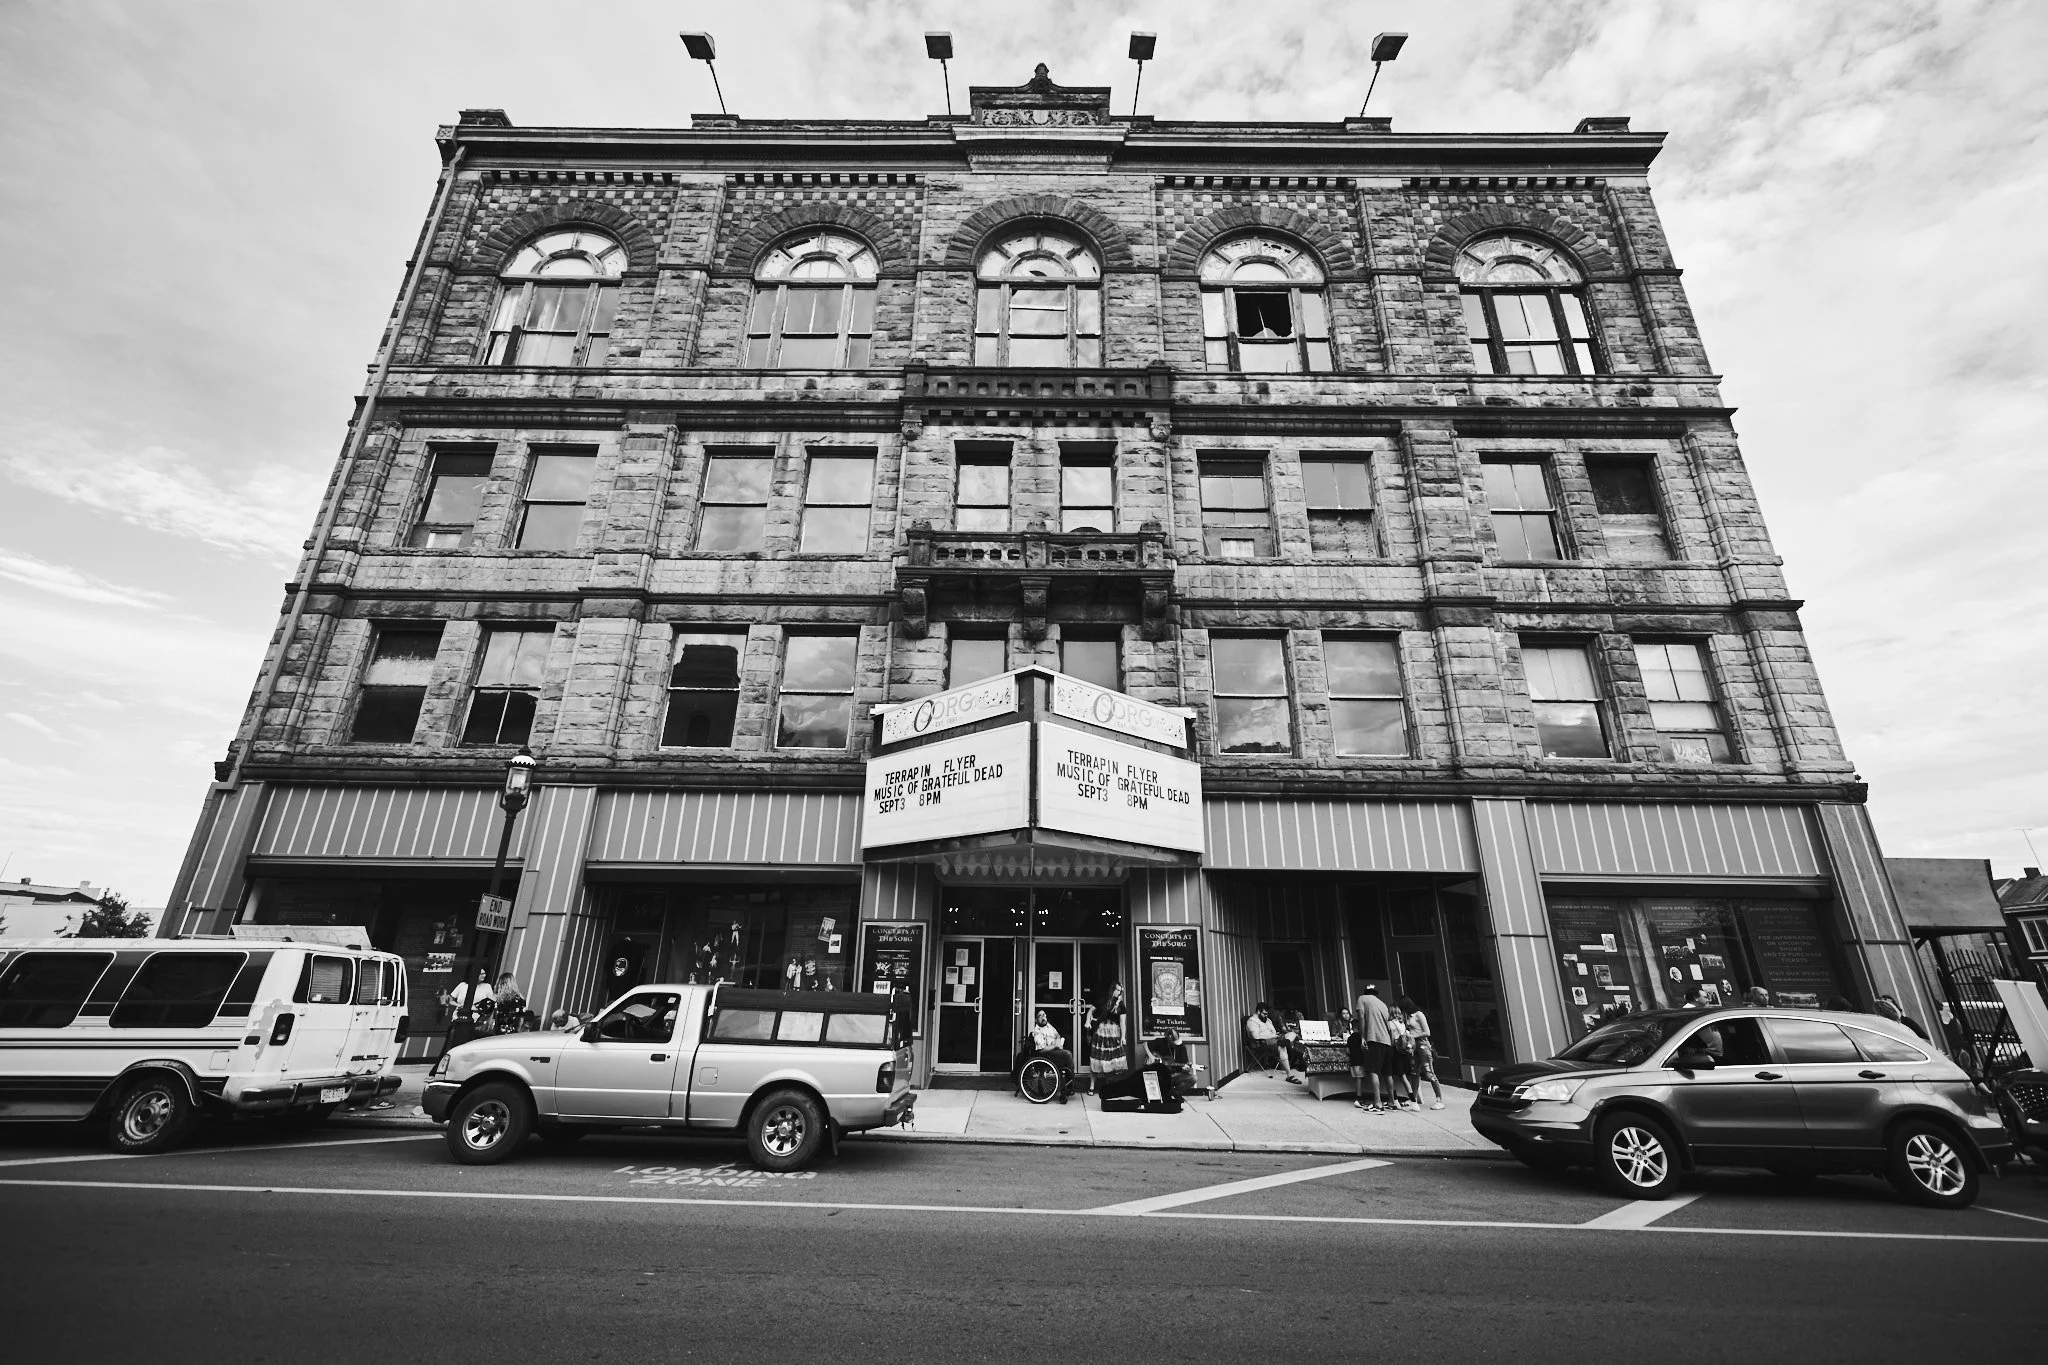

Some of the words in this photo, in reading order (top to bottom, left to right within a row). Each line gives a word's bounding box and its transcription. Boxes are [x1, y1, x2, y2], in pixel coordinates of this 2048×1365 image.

[885, 764, 931, 785] TERRAPIN
[943, 754, 976, 773] FLYER
[1067, 749, 1119, 775] TERRAPIN
[1127, 764, 1158, 784] FLYER
[874, 784, 903, 802] MUSIC
[907, 780, 919, 795] OF
[922, 770, 970, 792] GRATEFUL
[974, 764, 1003, 782] DEAD
[1057, 762, 1094, 783] MUSIC
[1098, 772, 1111, 787] OF
[1117, 777, 1165, 799] GRATEFUL
[1167, 788, 1190, 804] DEAD
[1127, 794, 1148, 810] 8PM
[490, 899, 502, 913] END
[480, 912, 493, 926] ROAD
[493, 915, 507, 928] WORK
[613, 1164, 818, 1179] LOADING
[628, 1174, 767, 1188] ZONE
